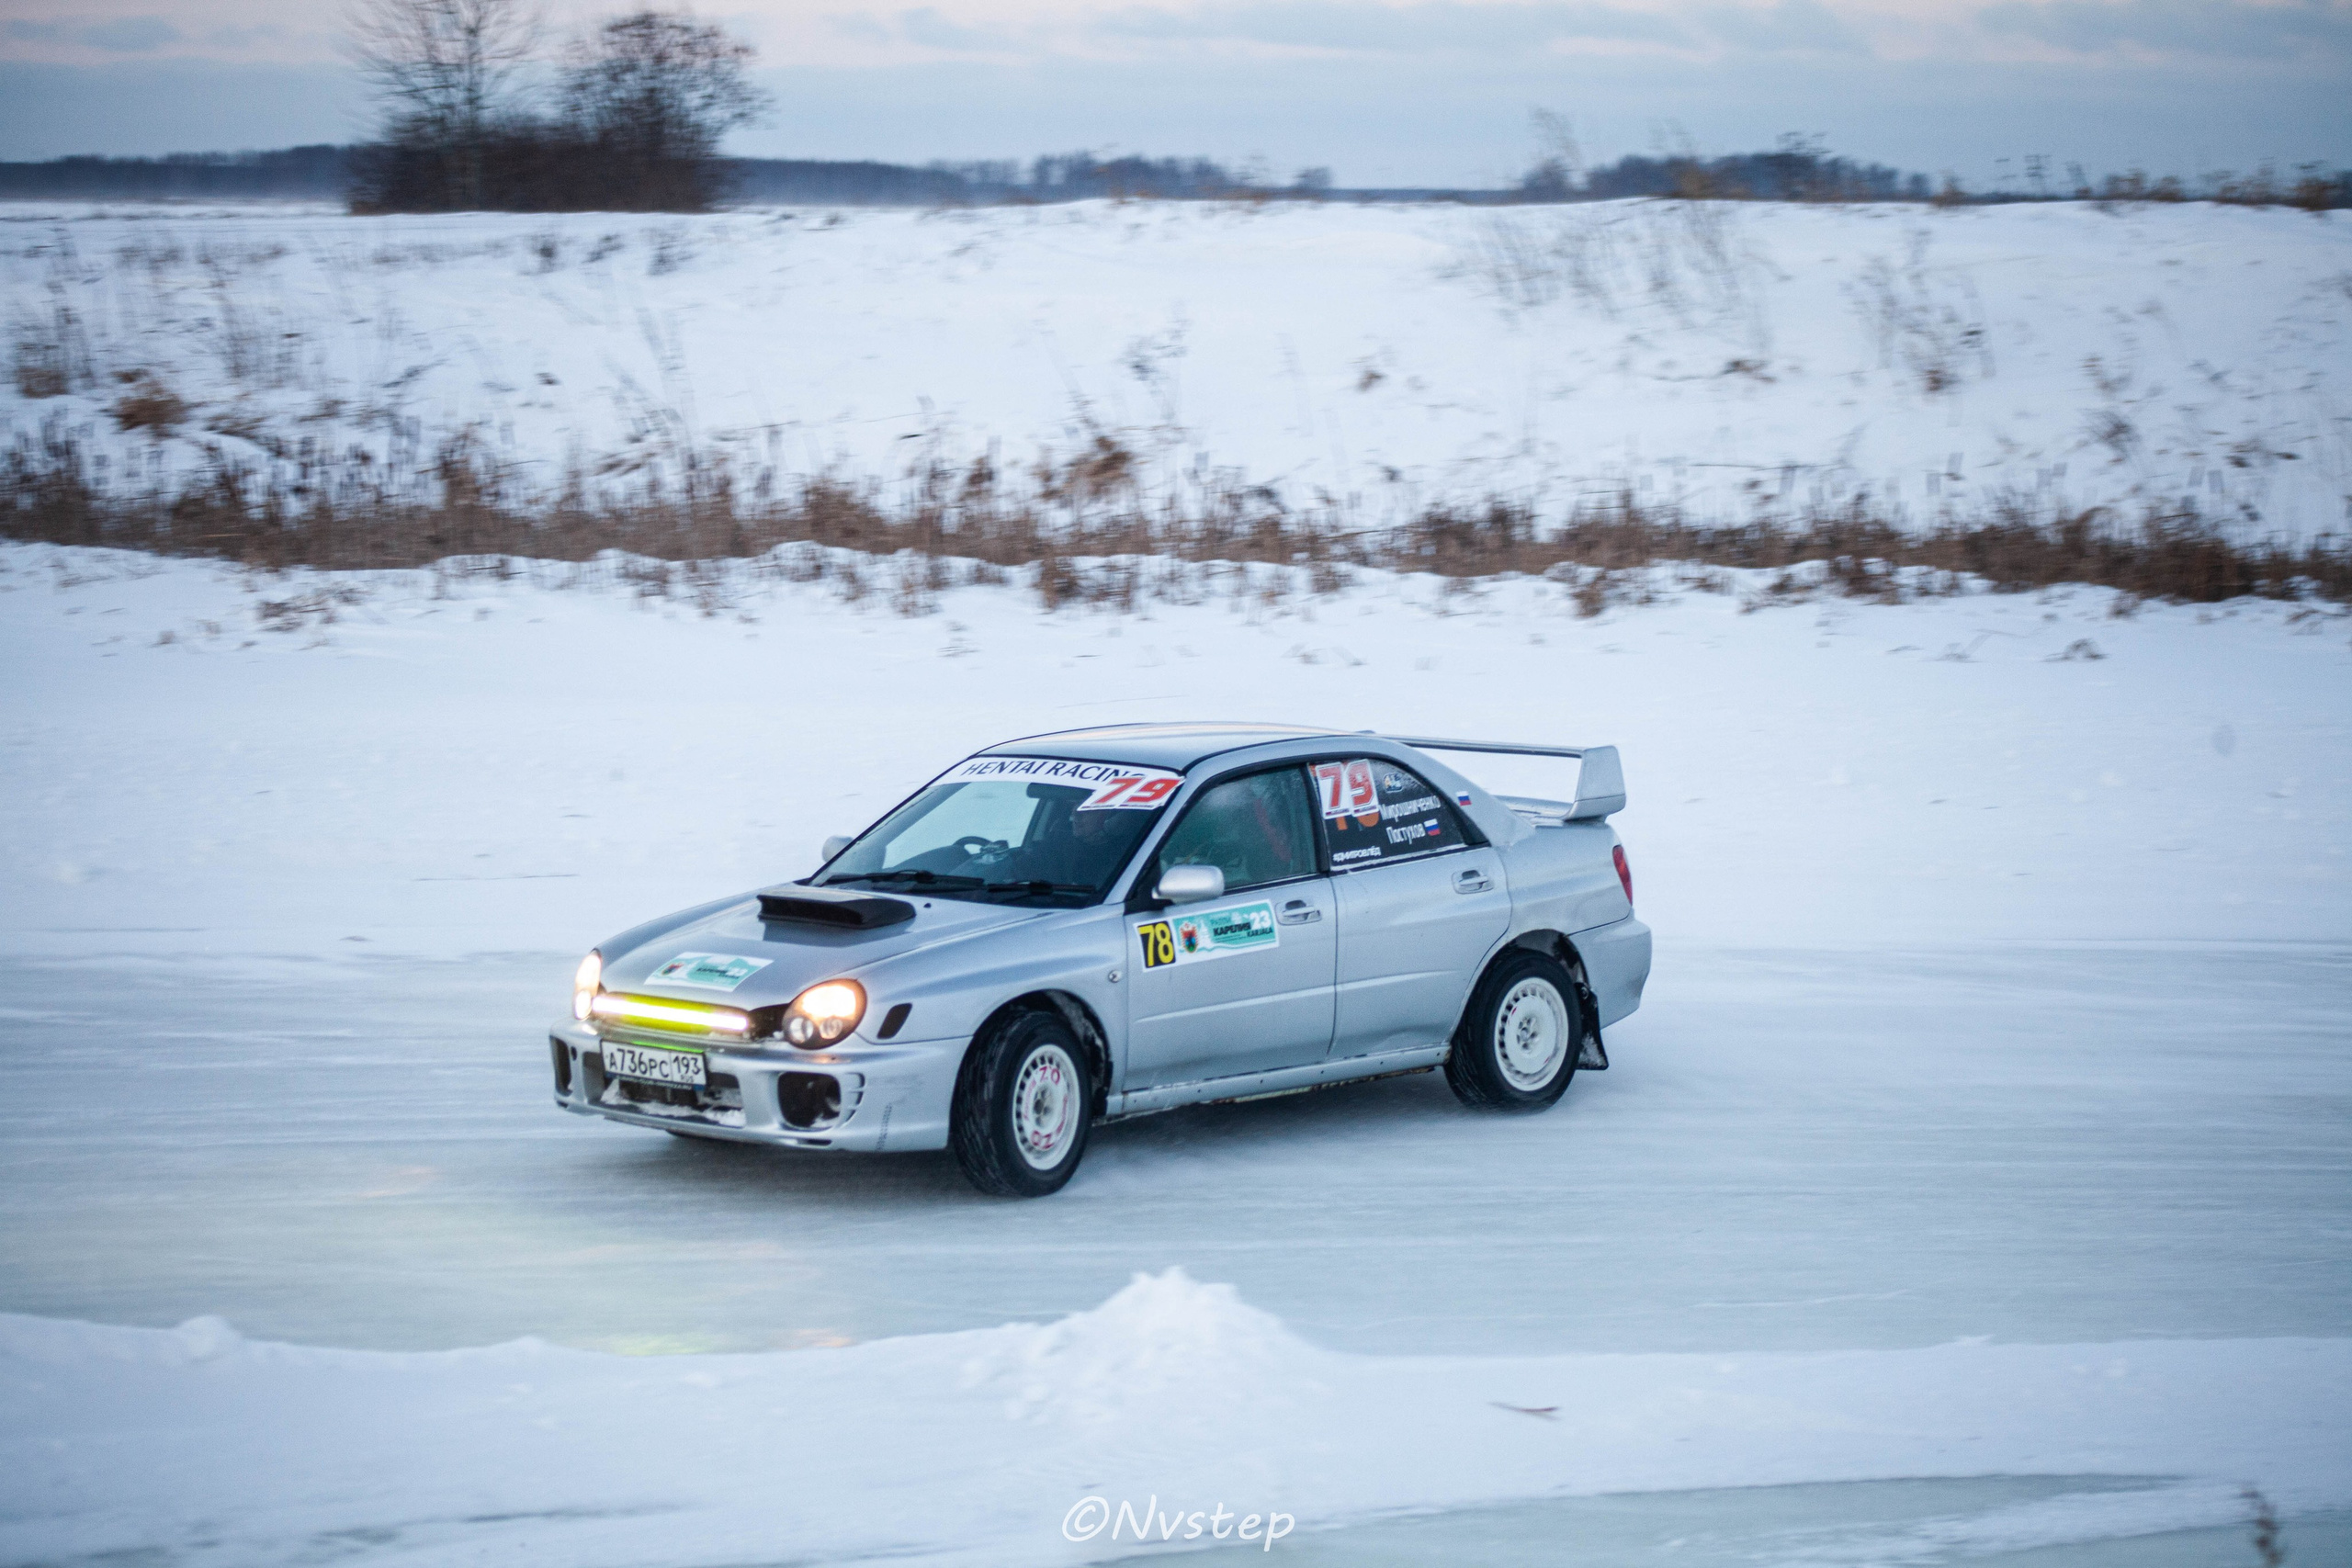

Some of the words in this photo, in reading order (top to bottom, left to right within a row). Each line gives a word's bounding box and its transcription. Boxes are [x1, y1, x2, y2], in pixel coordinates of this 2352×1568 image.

[961, 760, 1049, 776] HENTAI
[1046, 761, 1148, 782] RACIN
[1091, 777, 1182, 805] 79
[1317, 761, 1375, 809] 79
[1213, 921, 1251, 936] КАРЕЛИЯ
[1137, 922, 1175, 967] 78
[673, 1055, 701, 1076] 193
